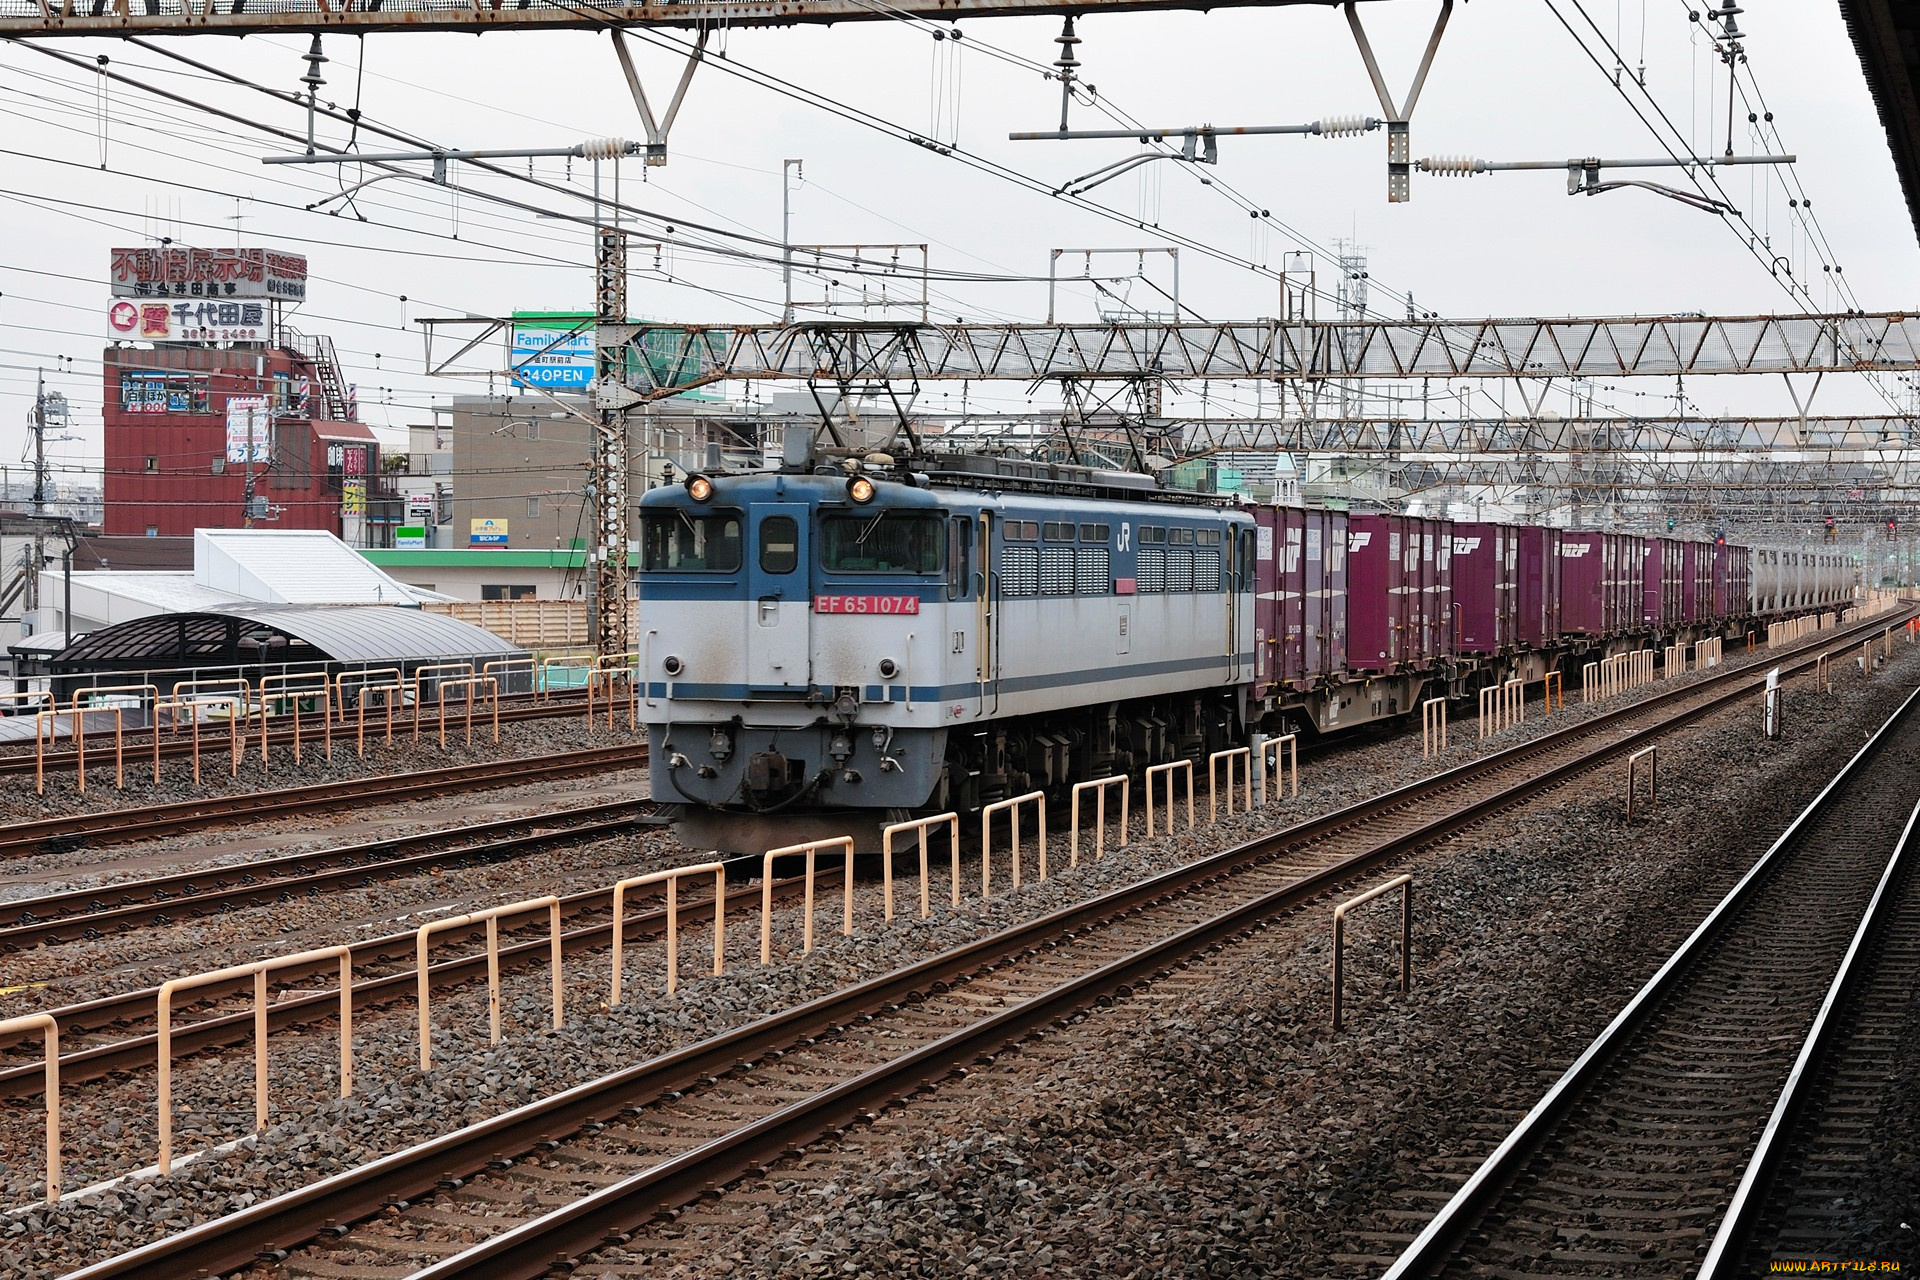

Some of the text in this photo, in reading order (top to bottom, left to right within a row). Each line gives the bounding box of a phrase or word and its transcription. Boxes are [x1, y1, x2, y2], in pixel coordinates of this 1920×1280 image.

[111, 249, 263, 282] 不動産展示場
[142, 307, 169, 333] 質
[172, 302, 263, 326] 千代田屋
[1117, 522, 1130, 552] JR
[873, 597, 916, 613] 1074
